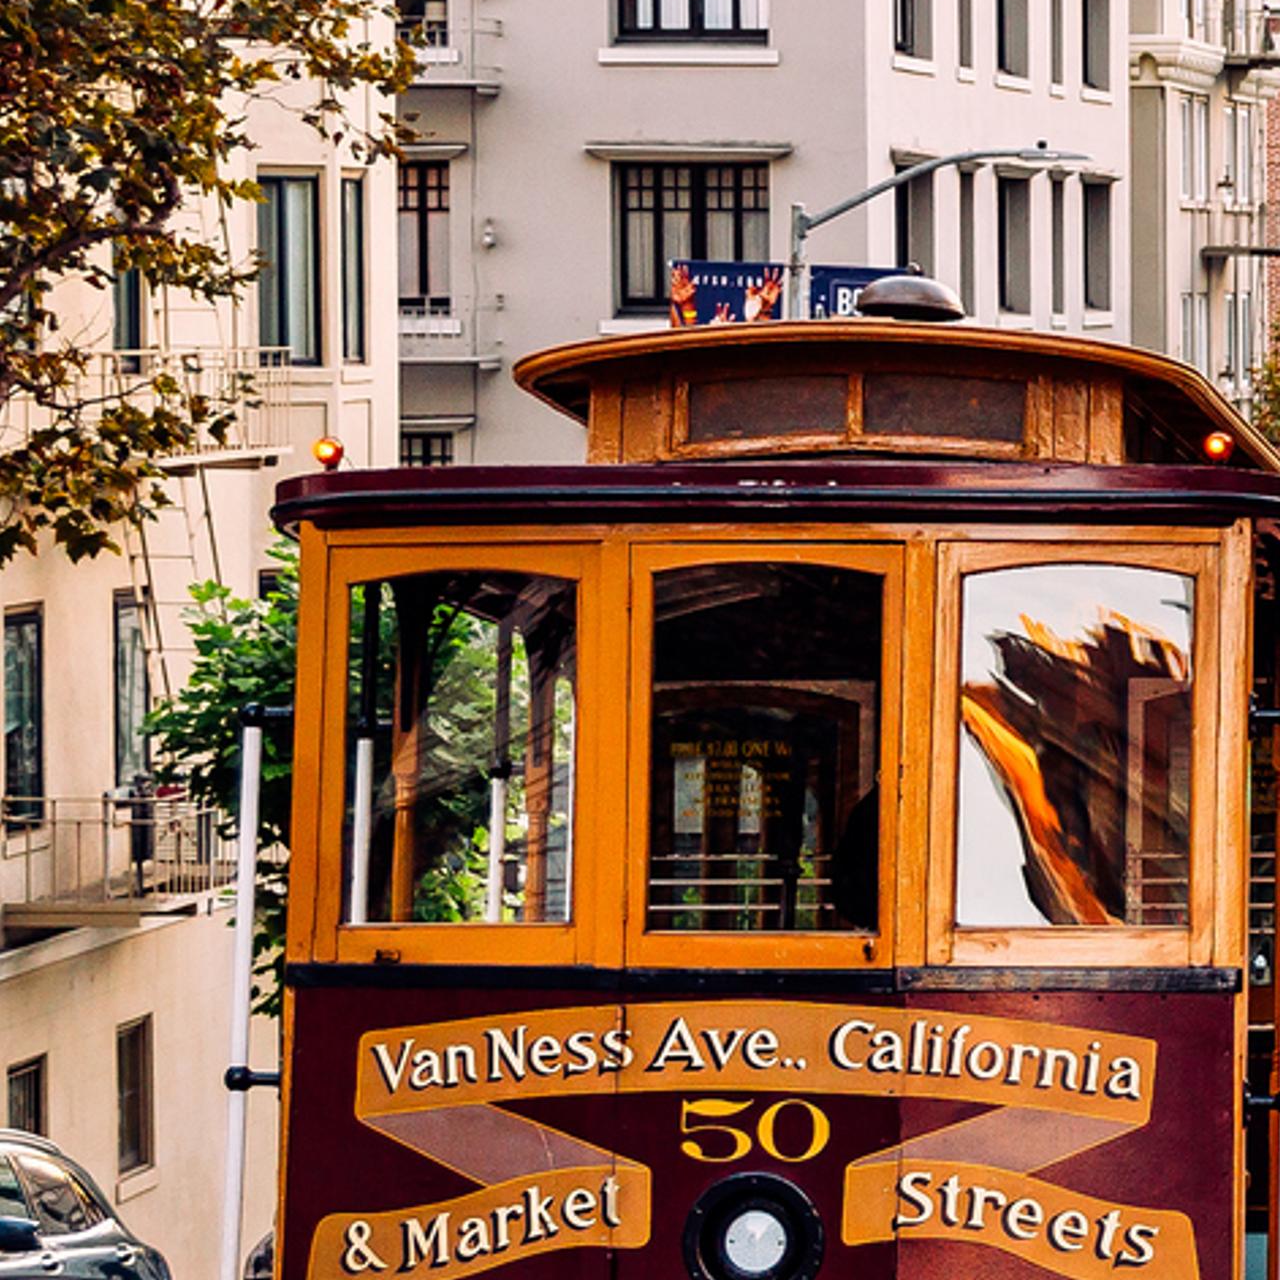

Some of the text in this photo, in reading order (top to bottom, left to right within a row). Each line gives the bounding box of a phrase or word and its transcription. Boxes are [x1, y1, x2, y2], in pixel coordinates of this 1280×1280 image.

[372, 1038, 478, 1094] Van
[484, 1023, 634, 1082] Ness
[831, 1018, 1141, 1099] California
[681, 1098, 831, 1163] 50
[342, 1173, 622, 1273] & Market
[893, 1170, 1161, 1269] Streets
